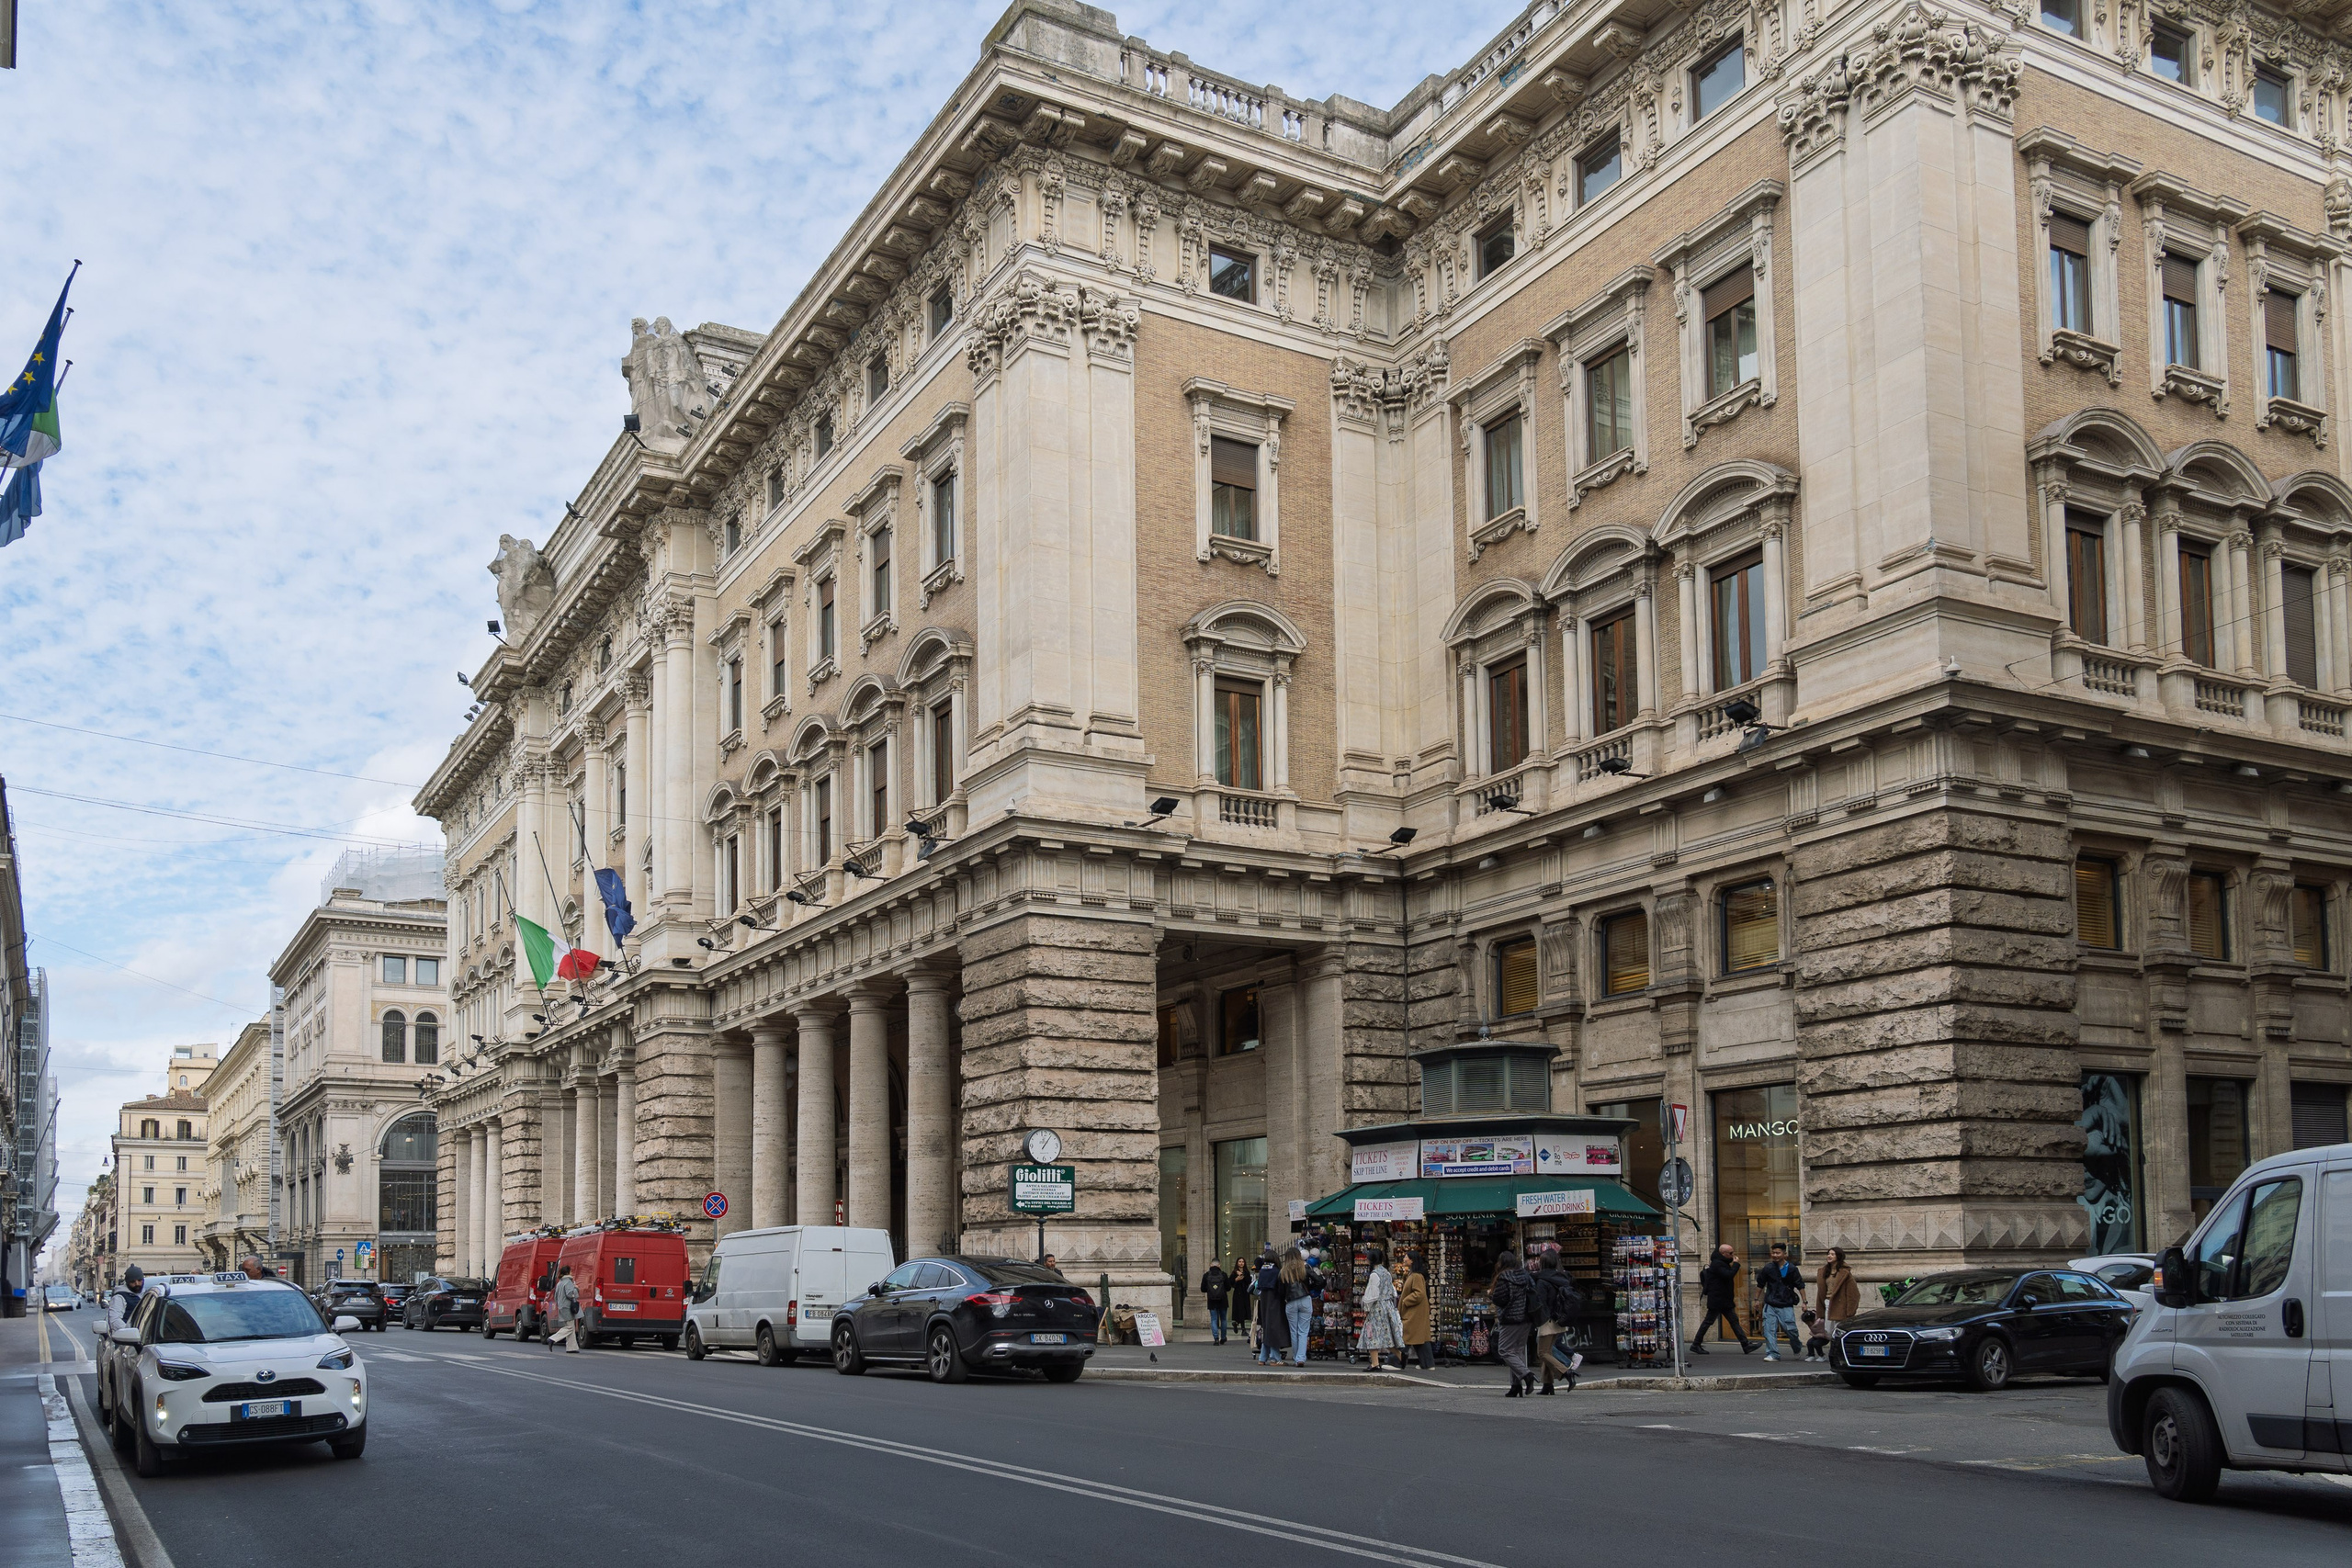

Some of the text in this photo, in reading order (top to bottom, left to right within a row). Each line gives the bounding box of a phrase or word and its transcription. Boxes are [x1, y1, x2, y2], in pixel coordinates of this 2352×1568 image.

[1729, 1120, 1798, 1139] MANGO
[1354, 1150, 1387, 1165] TICKETS
[1353, 1166, 1387, 1176] SKIP THE LINE
[1521, 1193, 1566, 1205] FRESH WATER
[1358, 1202, 1393, 1211] TICKETS
[1543, 1202, 1585, 1213] COLD DRINKS
